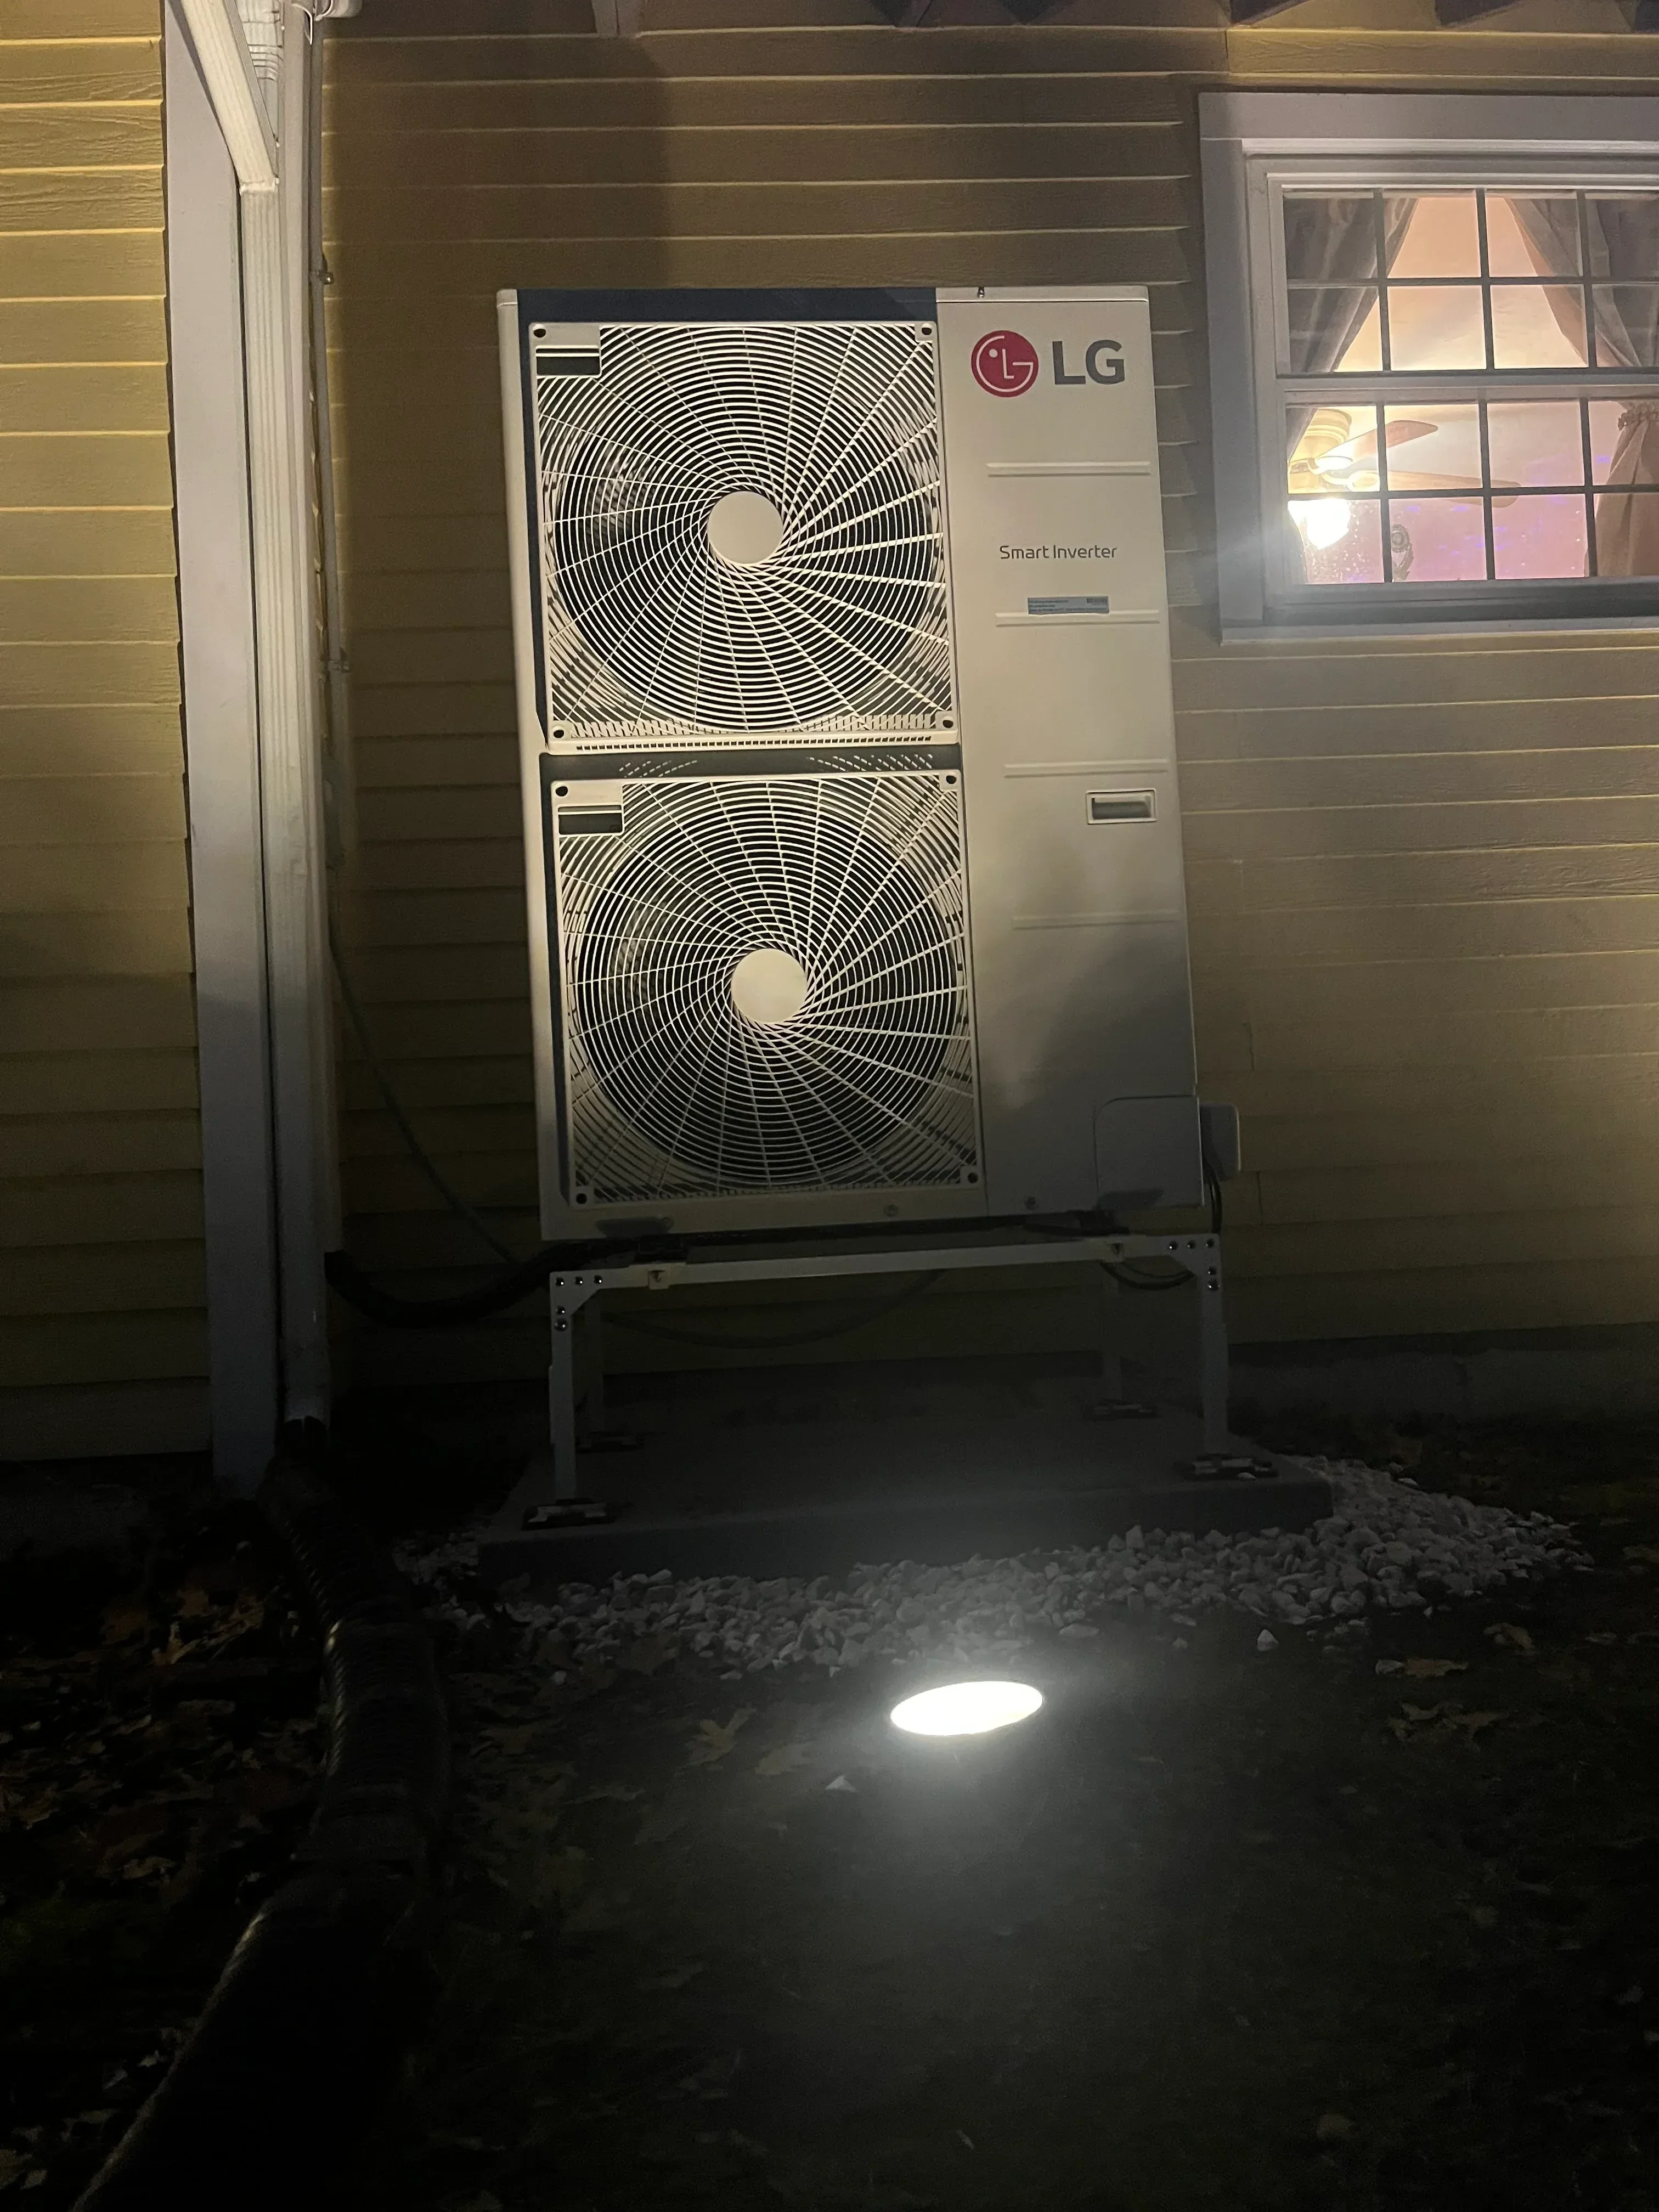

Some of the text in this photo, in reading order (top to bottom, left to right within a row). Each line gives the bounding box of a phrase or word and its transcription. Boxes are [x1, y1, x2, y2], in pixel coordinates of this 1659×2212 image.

[1052, 339, 1125, 385] LG
[999, 544, 1118, 560] Smart Inverter
